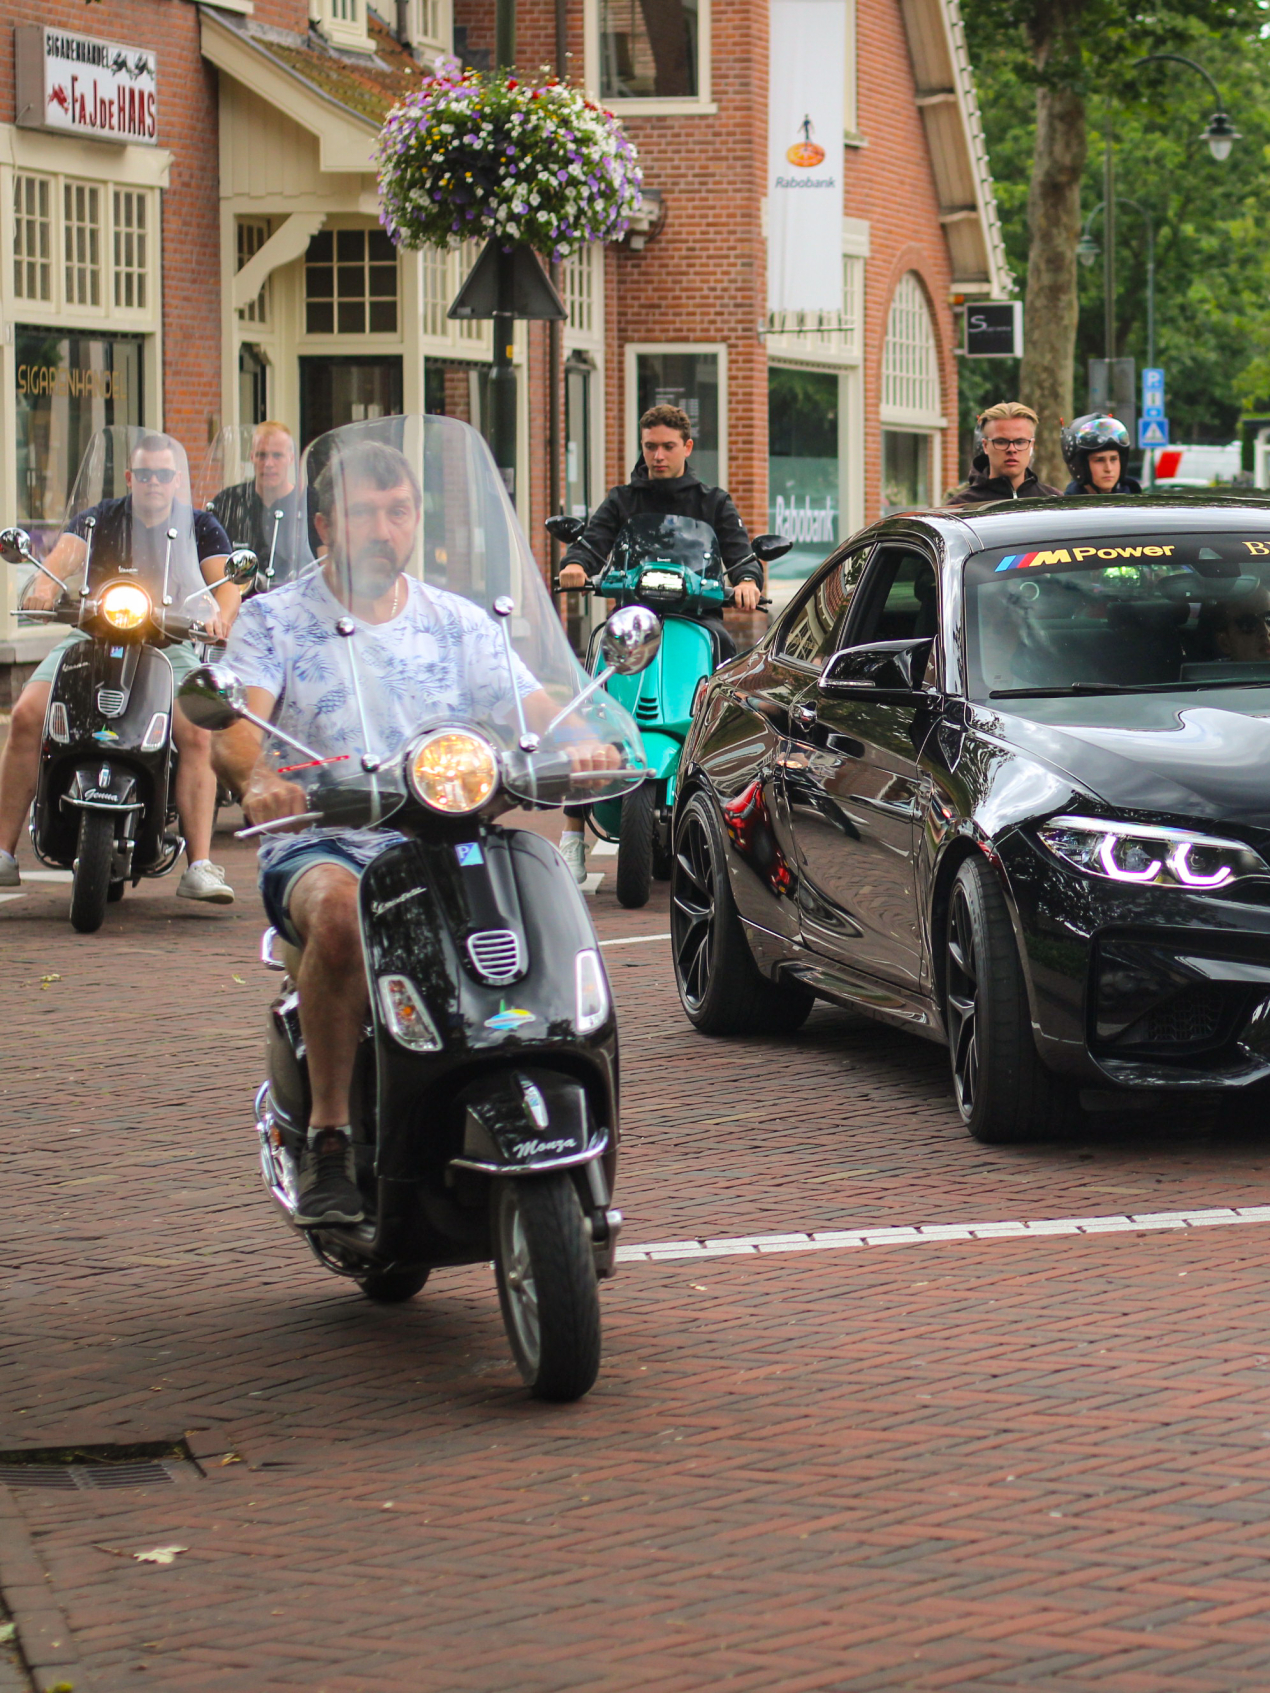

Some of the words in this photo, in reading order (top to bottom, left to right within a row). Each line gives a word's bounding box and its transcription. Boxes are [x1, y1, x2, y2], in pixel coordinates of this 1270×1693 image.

[46, 33, 110, 69] SIGARENHANDEL
[117, 84, 156, 139] HAAS
[775, 176, 836, 189] Rabobank
[18, 364, 127, 400] SIGARENHANDEL
[775, 495, 835, 543] Rabobank
[512, 1138, 578, 1158] Monza
